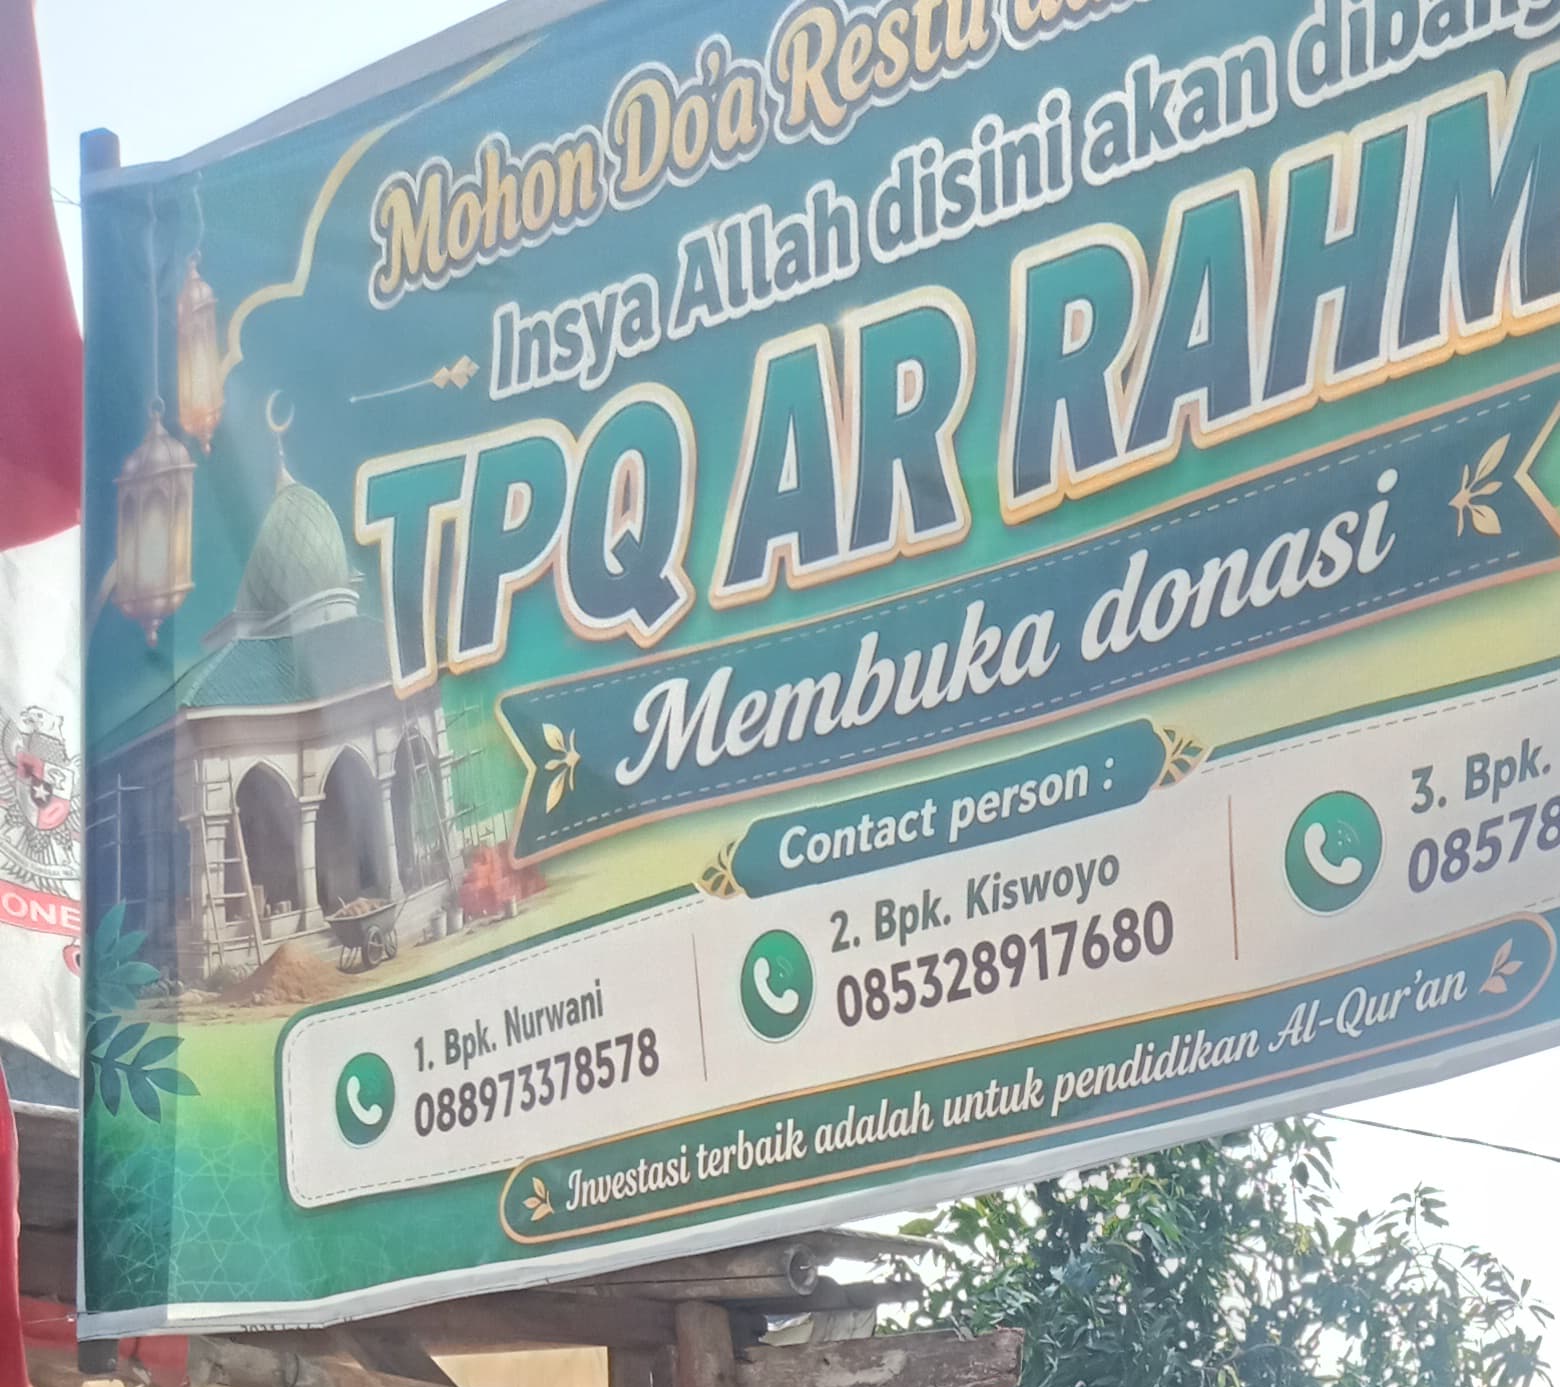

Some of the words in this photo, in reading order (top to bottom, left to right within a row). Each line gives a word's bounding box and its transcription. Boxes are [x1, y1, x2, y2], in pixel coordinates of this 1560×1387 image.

[371, 135, 600, 306] Mohon
[608, 40, 764, 203] Do'a
[770, 0, 995, 139] Restu
[490, 275, 659, 401] Insya
[667, 178, 860, 339] Allah
[870, 89, 1071, 265] disini
[1084, 38, 1276, 186] akan
[354, 386, 696, 702] TPQ
[708, 286, 975, 609] AR
[614, 600, 1061, 787] Membuka
[1080, 467, 1400, 662] donasi
[778, 803, 936, 870] Contact
[948, 764, 1089, 843] person
[1410, 766, 1446, 815] 3.
[1463, 738, 1552, 805] Bpk.
[830, 909, 861, 954] 2.
[874, 888, 951, 946] Bpk.
[966, 853, 1120, 921] Kiswoyo
[836, 900, 1175, 1028] 085328917680
[414, 1036, 434, 1073] 1.
[444, 1017, 498, 1071] Bpk.
[505, 978, 604, 1049] Nurwani
[414, 1027, 660, 1137] 088973378578
[565, 1145, 690, 1212] Investasi
[695, 1118, 808, 1181] terbaik
[814, 1090, 934, 1154] adalah
[942, 1067, 1045, 1128] untuk
[1052, 1028, 1260, 1118] pendidikan
[1267, 968, 1468, 1054] Al-Qur'an
